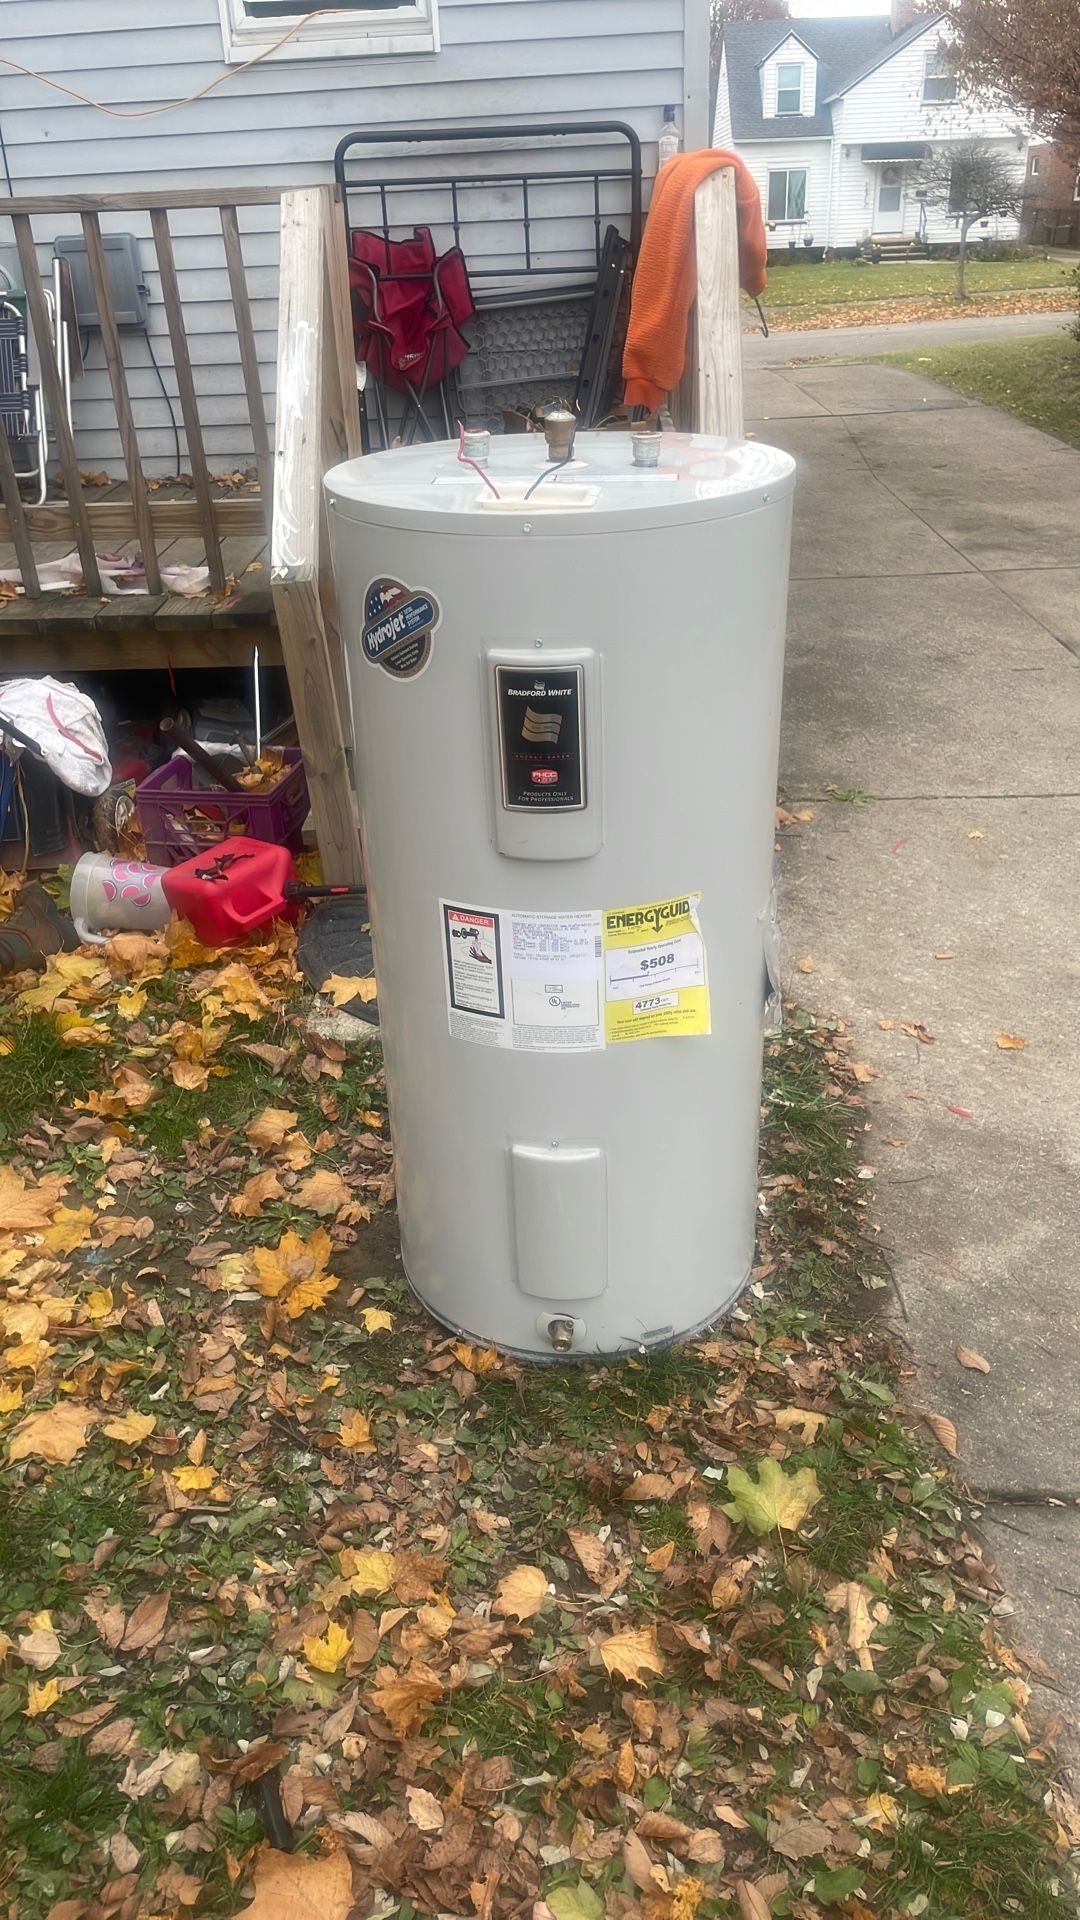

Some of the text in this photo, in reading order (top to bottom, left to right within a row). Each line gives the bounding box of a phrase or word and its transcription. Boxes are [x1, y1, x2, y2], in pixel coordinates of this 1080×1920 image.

[367, 611, 405, 651] Hydrojet
[508, 688, 572, 696] BRADFORD WHITE
[460, 915, 489, 926] DANGER
[606, 900, 690, 932] ENERGYGUID
[640, 953, 675, 971] $508
[635, 997, 661, 1009] 4773
